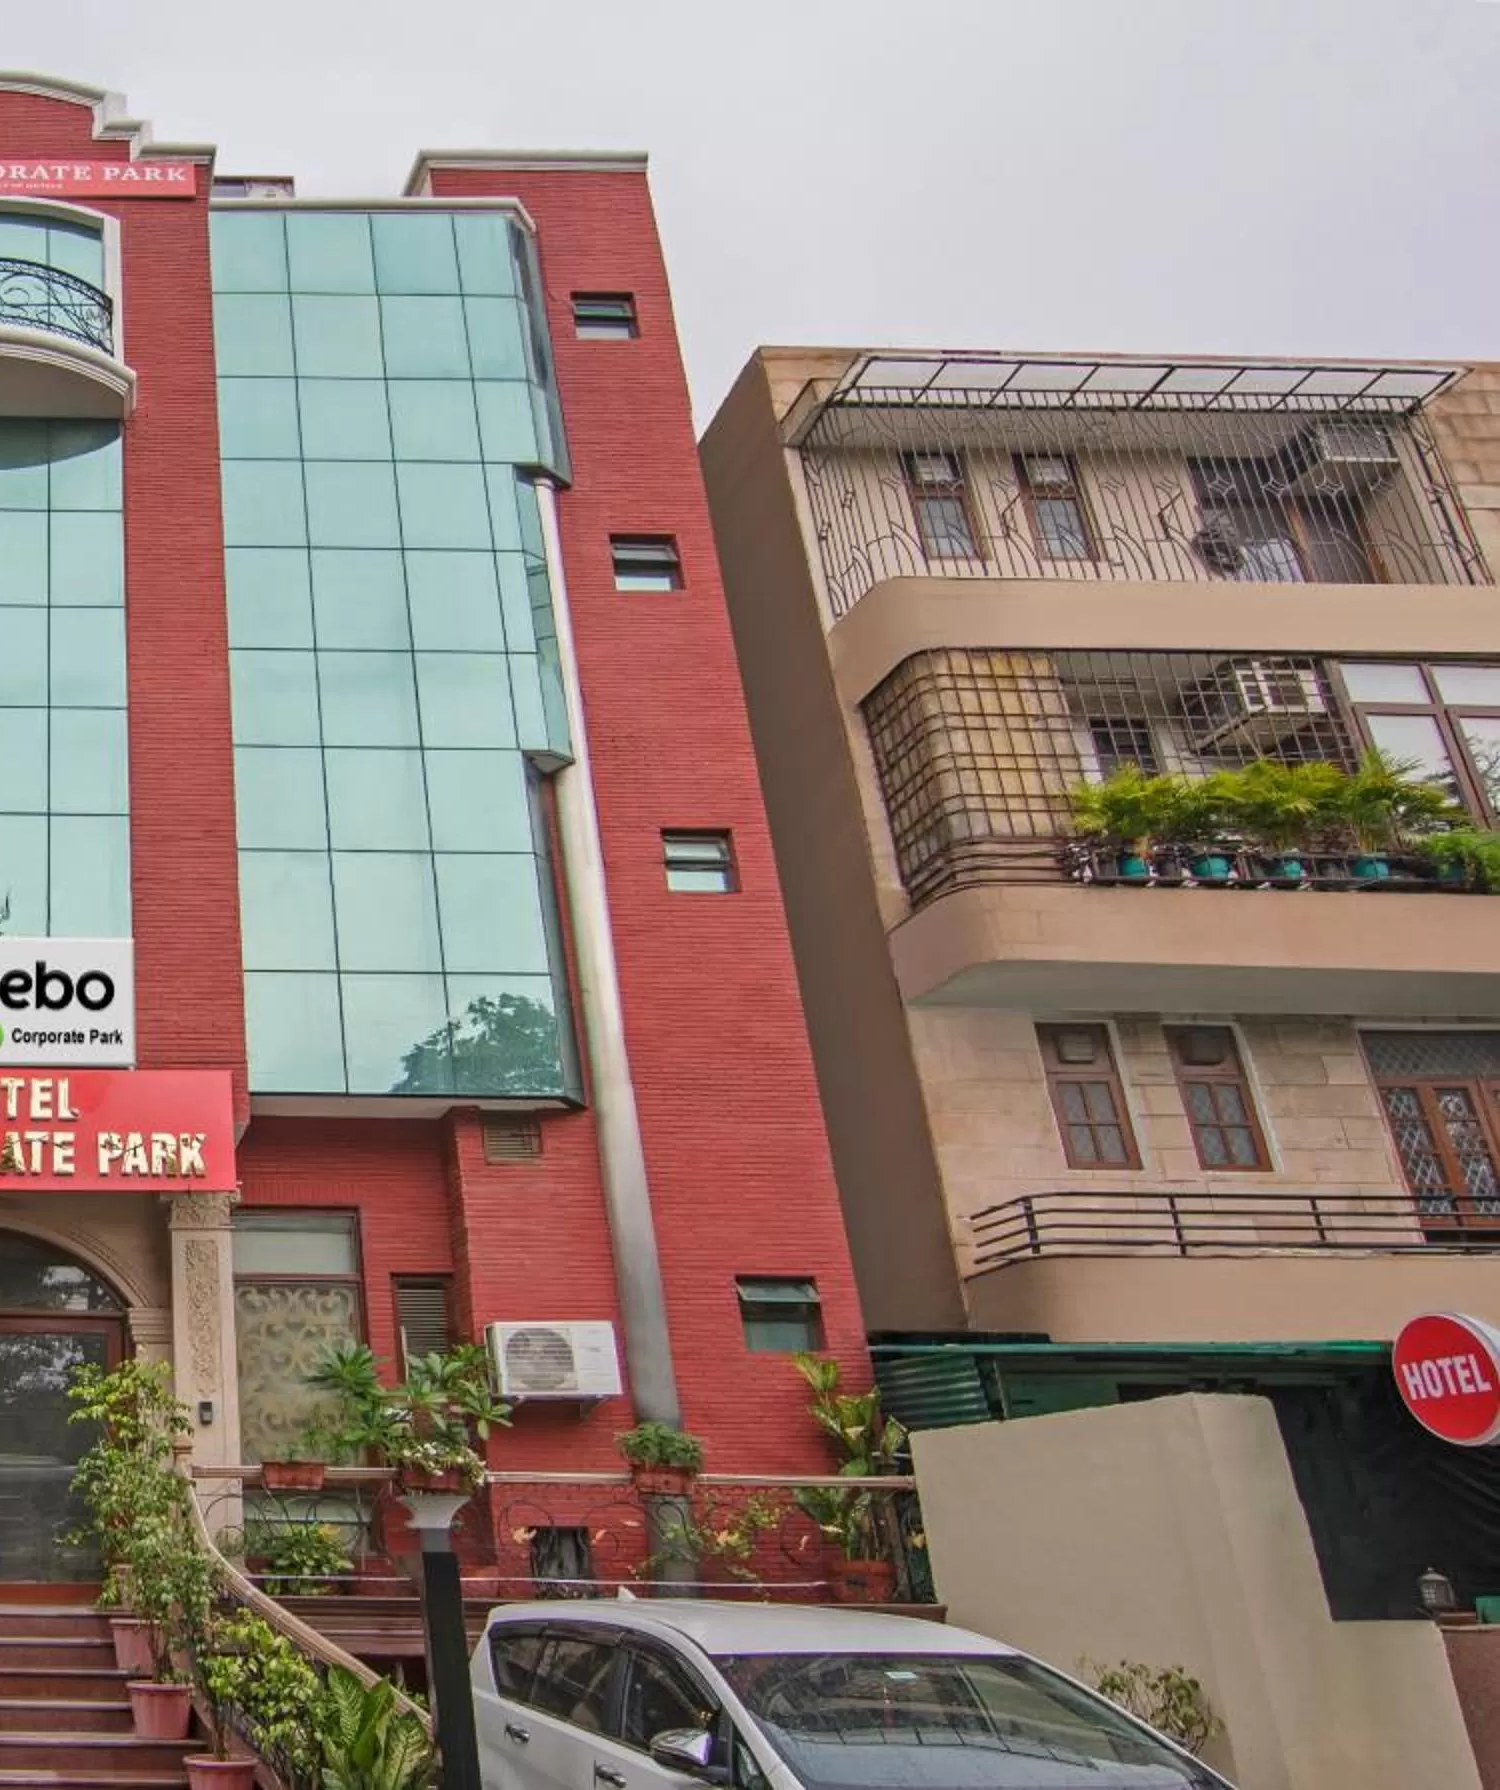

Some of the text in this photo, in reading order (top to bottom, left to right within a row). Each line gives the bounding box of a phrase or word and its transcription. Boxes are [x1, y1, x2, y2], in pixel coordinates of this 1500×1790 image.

[103, 166, 186, 181] PARK
[11, 1027, 124, 1045] Corporate Park
[98, 1133, 208, 1178] PARK
[1401, 1353, 1492, 1401] HOTEL
